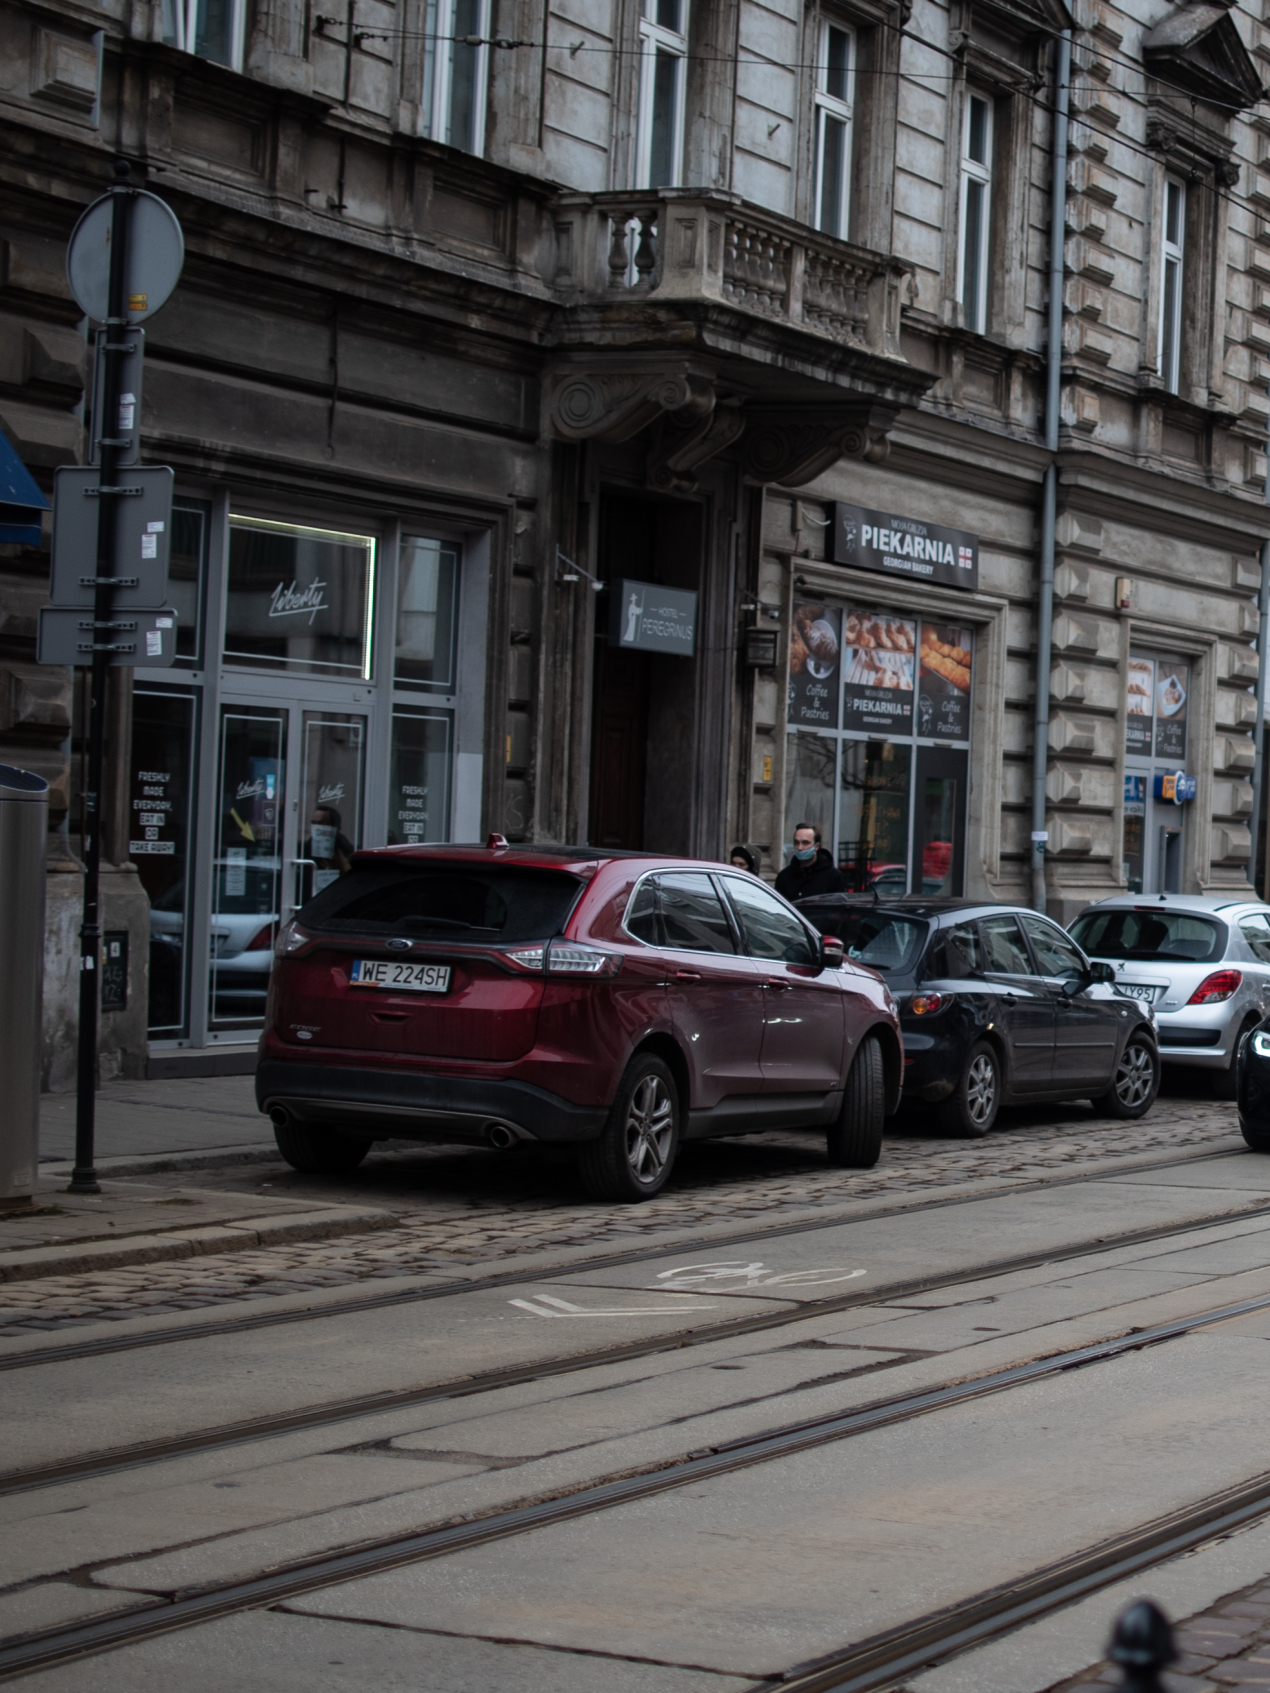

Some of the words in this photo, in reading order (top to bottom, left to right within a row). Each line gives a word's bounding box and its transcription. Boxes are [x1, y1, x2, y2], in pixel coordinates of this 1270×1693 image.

[861, 524, 955, 566] PIEKARNIA
[883, 556, 912, 570] GEORGIAN
[912, 561, 934, 575] BAKERY
[269, 577, 328, 625] Liberty
[659, 607, 678, 618] HOSTEL
[642, 618, 693, 640] PEREGRINUS
[806, 683, 828, 698] Coffee
[853, 698, 903, 716] PIEKARNIA
[941, 700, 961, 713] Coffee
[801, 706, 830, 721] Pastries
[937, 721, 962, 734] Pastries
[1166, 724, 1183, 736] Coffee
[1163, 743, 1183, 755] Pastries
[138, 771, 171, 782] FRESHLY
[402, 785, 428, 795] FRESHLY
[141, 814, 156, 825] EAT
[131, 842, 149, 852] TAKE
[363, 962, 388, 982] WE
[393, 965, 448, 987] 224SH
